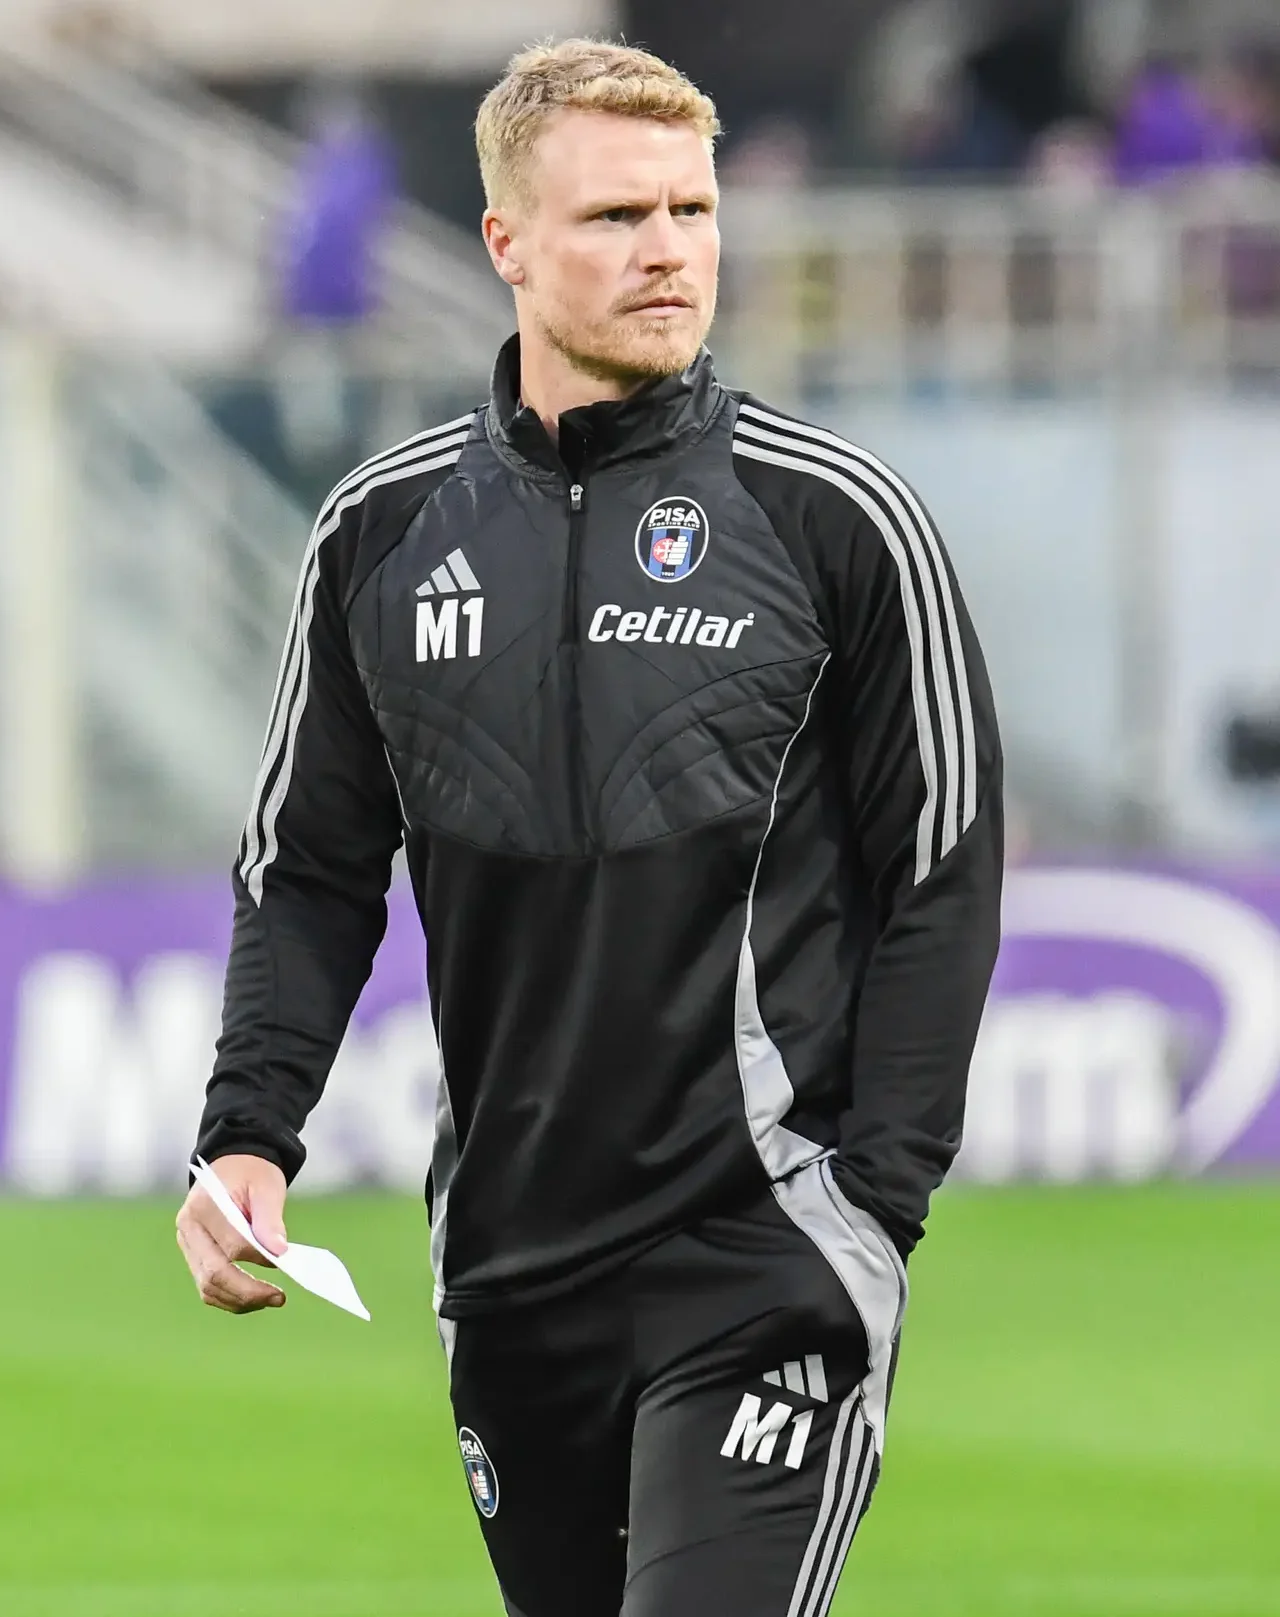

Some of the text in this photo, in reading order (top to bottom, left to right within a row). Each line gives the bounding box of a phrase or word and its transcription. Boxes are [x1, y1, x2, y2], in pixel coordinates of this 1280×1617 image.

[649, 507, 700, 525] PISA
[416, 597, 484, 663] M1
[588, 604, 755, 649] Cetilar
[720, 1392, 815, 1470] M1
